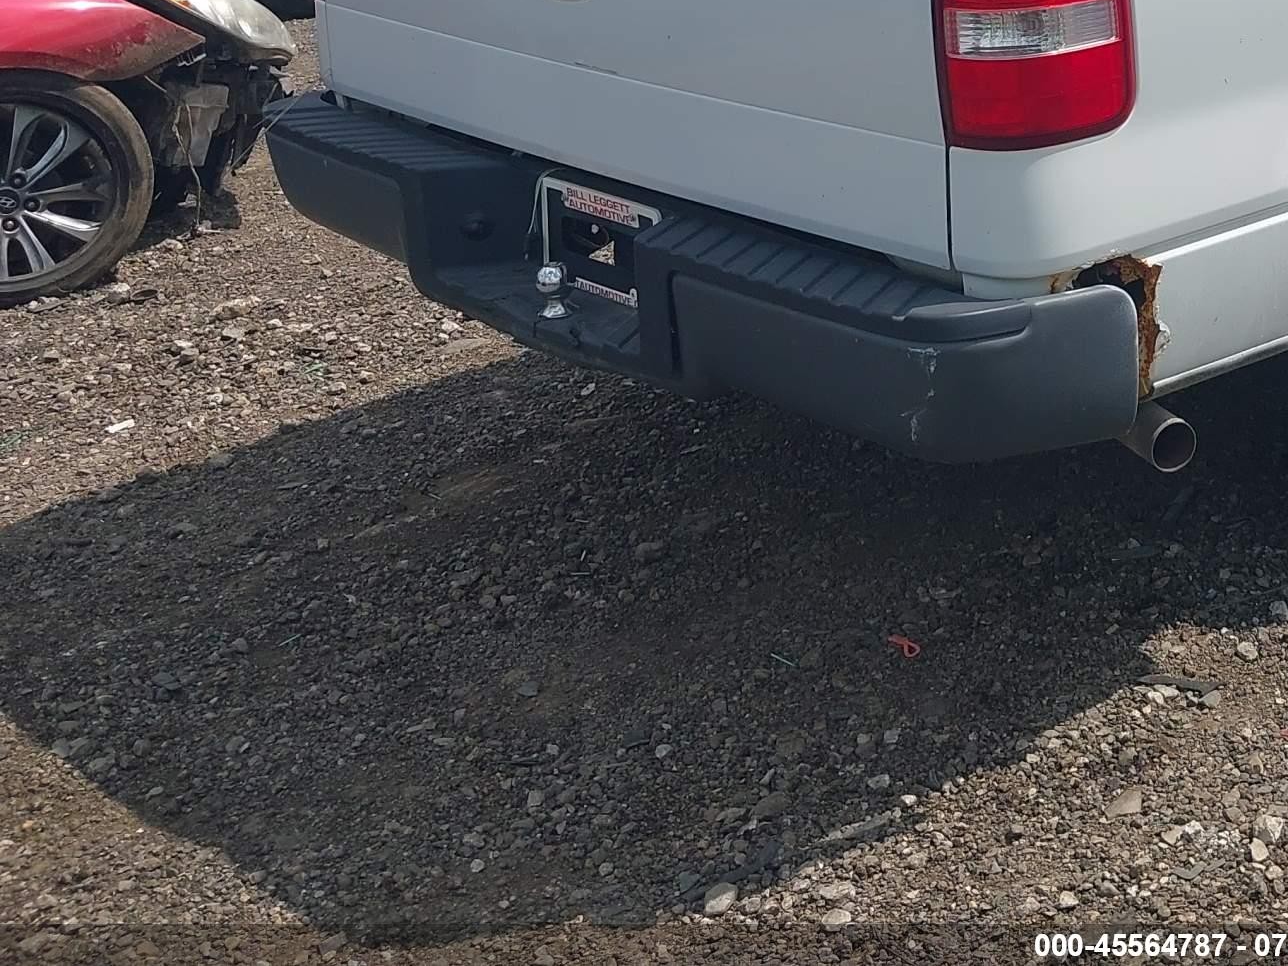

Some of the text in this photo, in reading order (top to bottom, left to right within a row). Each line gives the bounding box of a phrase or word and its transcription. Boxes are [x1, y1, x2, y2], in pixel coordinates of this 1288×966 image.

[566, 187, 630, 214] BILL LEGGETT
[569, 199, 633, 225] AUTOMOTIVE
